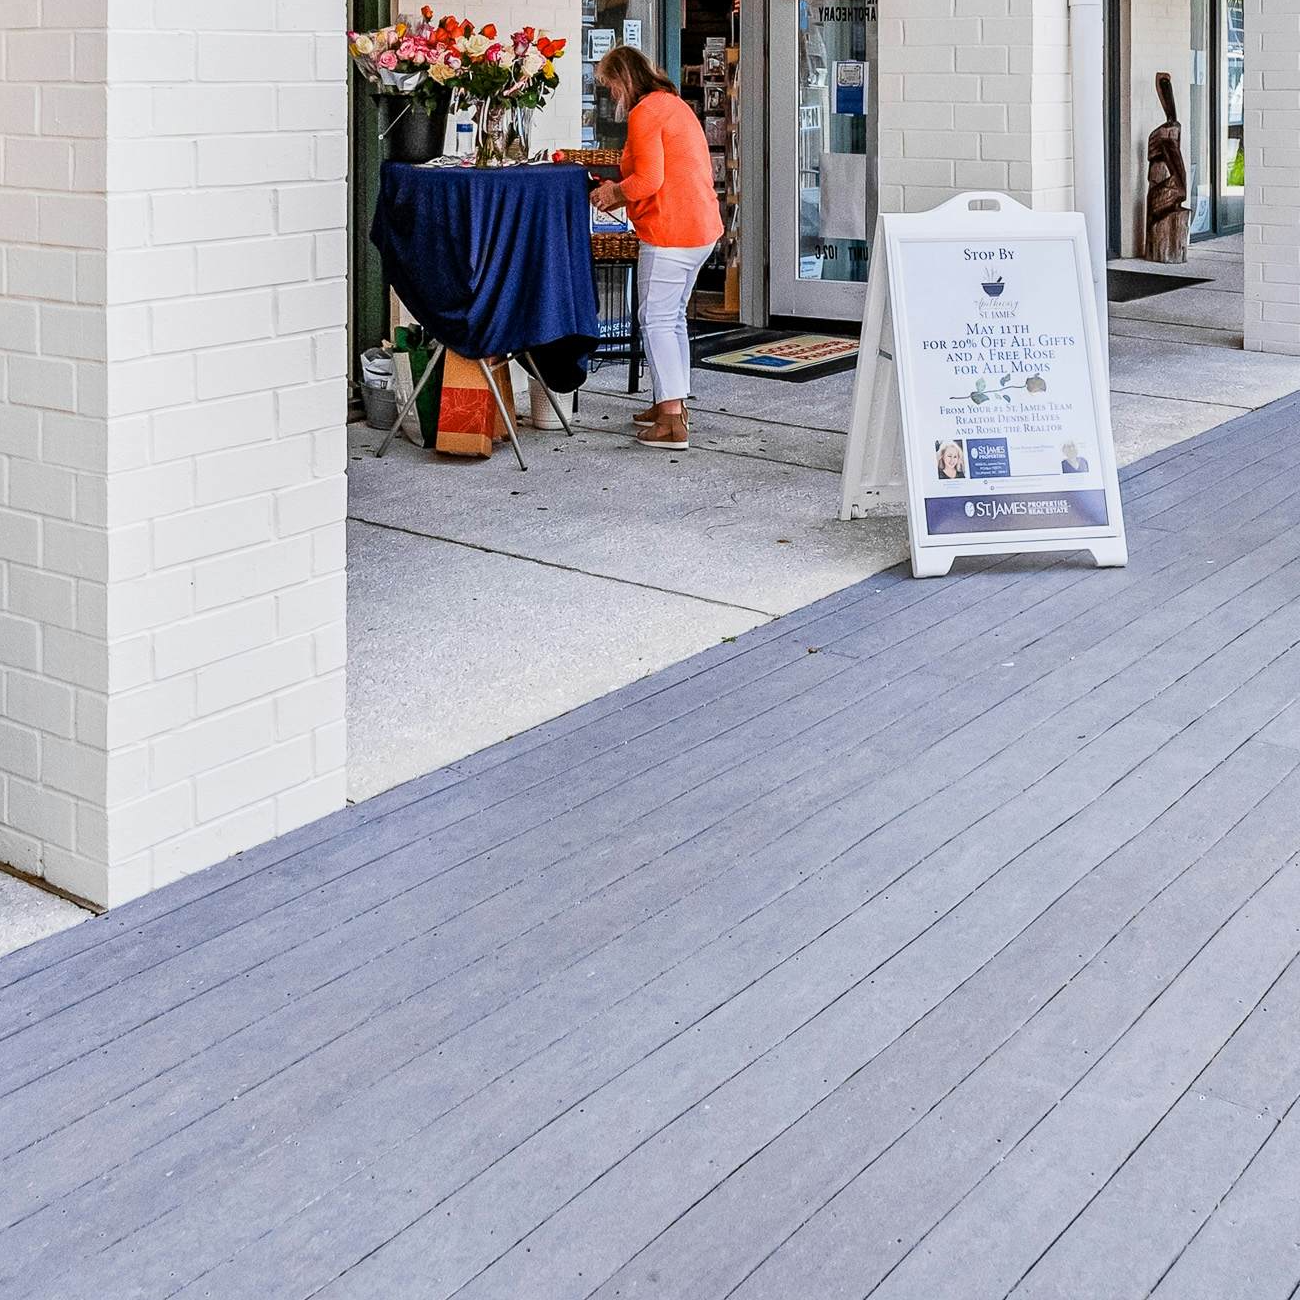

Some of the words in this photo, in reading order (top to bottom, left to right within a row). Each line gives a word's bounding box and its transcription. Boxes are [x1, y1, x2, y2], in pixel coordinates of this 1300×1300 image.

[964, 248, 995, 260] STOP
[999, 248, 1014, 260] BY
[966, 323, 995, 335] MAY
[1000, 324, 1030, 334] 11TH
[923, 340, 947, 350] FOR
[952, 337, 977, 349] 20%
[980, 336, 1006, 348] OFF
[1010, 335, 1035, 347] ALL
[1038, 334, 1075, 346] GIFTS
[946, 352, 973, 362] AND
[977, 352, 985, 361] A
[989, 349, 1020, 361] FREE
[1024, 348, 1055, 360] ROSE
[954, 365, 978, 375] FOR
[982, 362, 1007, 374] ALL
[1011, 361, 1050, 373] MOMS
[940, 406, 965, 415] FROM
[966, 404, 991, 414] YOUR
[1019, 403, 1046, 413] JAMES
[1049, 402, 1073, 411] TEAM
[956, 415, 995, 425] REALTOR
[955, 428, 974, 436] AND
[1023, 423, 1062, 433] REALTOR
[1027, 500, 1068, 508] PROPERTIES
